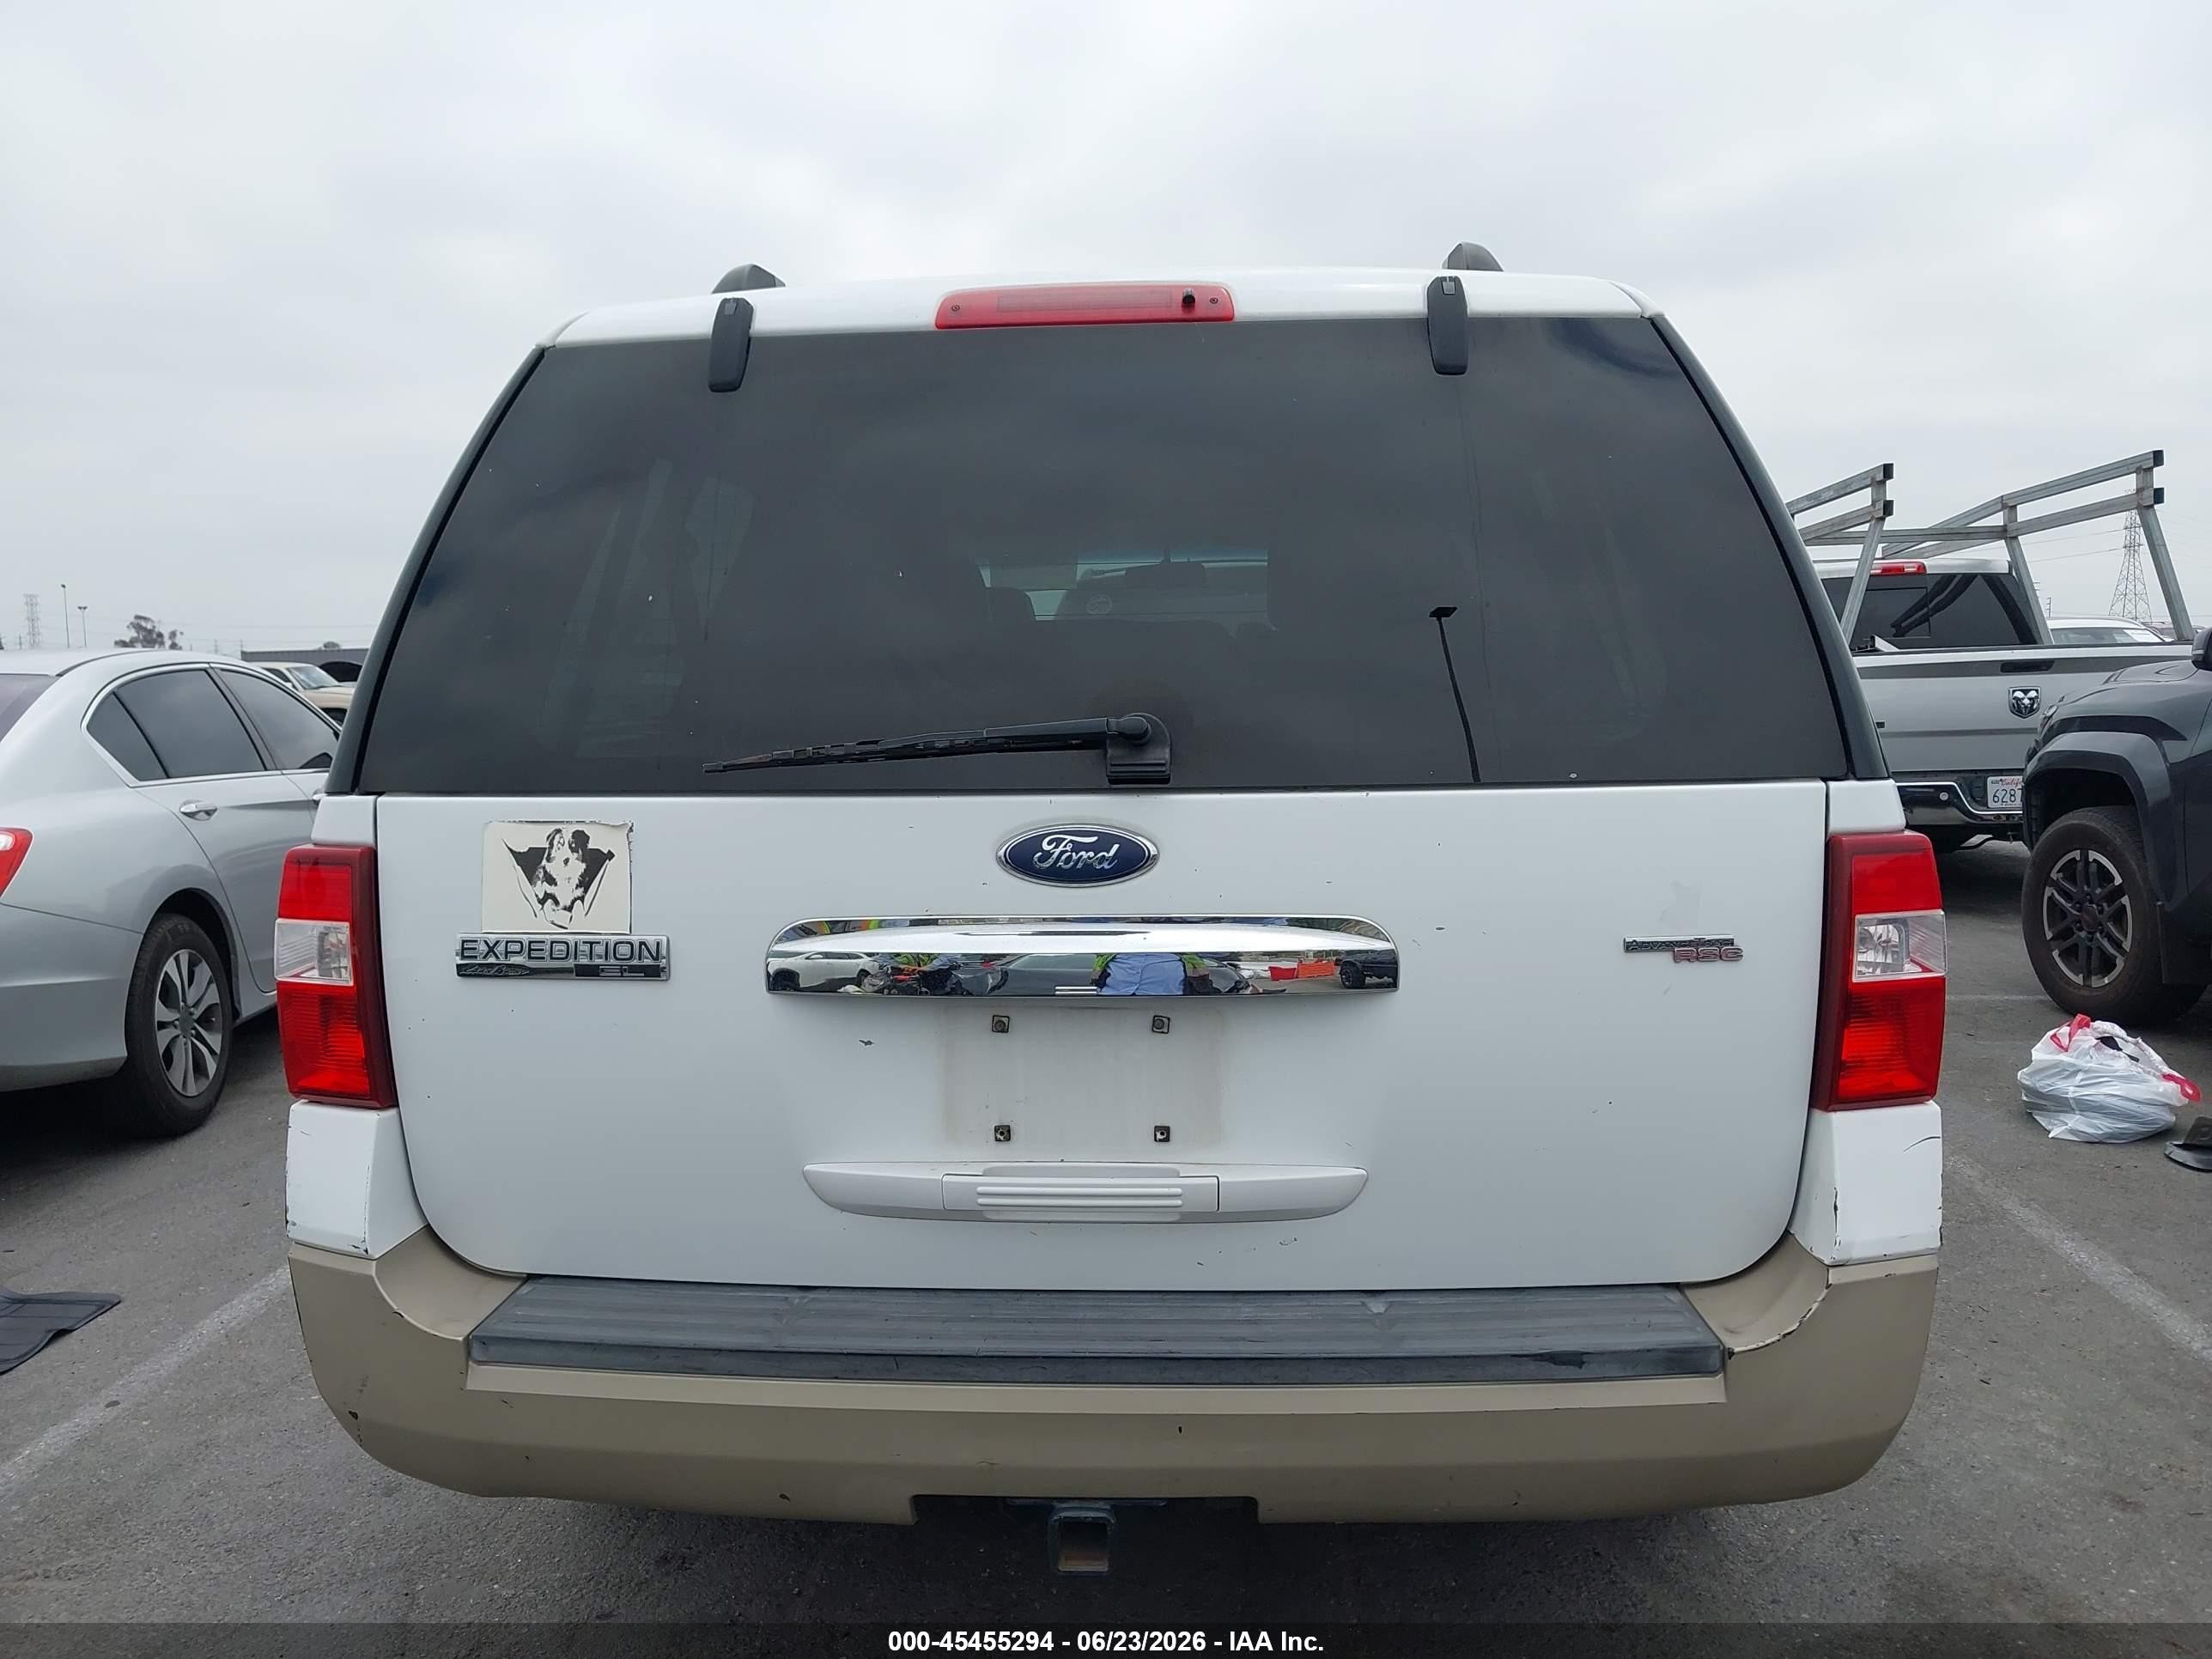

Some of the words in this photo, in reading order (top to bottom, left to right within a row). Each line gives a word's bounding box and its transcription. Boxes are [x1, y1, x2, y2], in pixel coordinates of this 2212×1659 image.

[1033, 834, 1120, 870] Ford
[459, 939, 662, 963] EXPEDITION
[1673, 946, 1745, 963] RSC
[599, 965, 646, 977] EL
